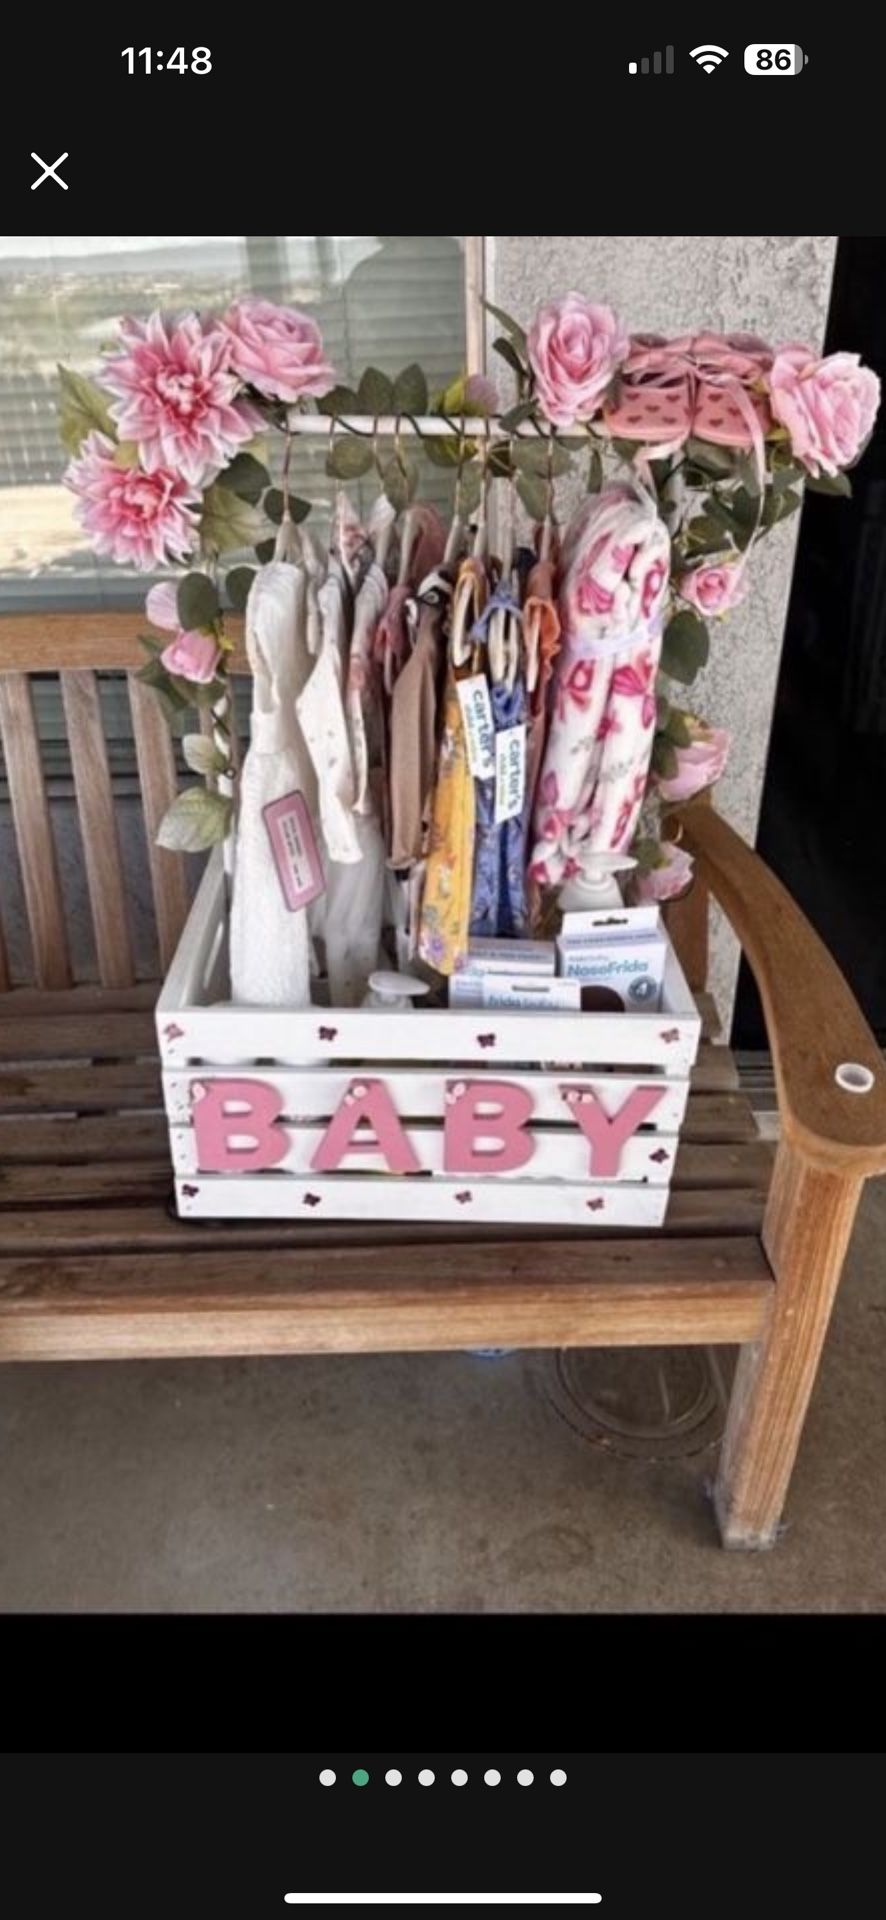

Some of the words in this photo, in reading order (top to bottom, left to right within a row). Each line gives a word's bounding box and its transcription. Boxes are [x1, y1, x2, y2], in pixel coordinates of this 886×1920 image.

[472, 688, 491, 768] carter's
[507, 738, 522, 810] carter's
[189, 1077, 669, 1178] BABY
